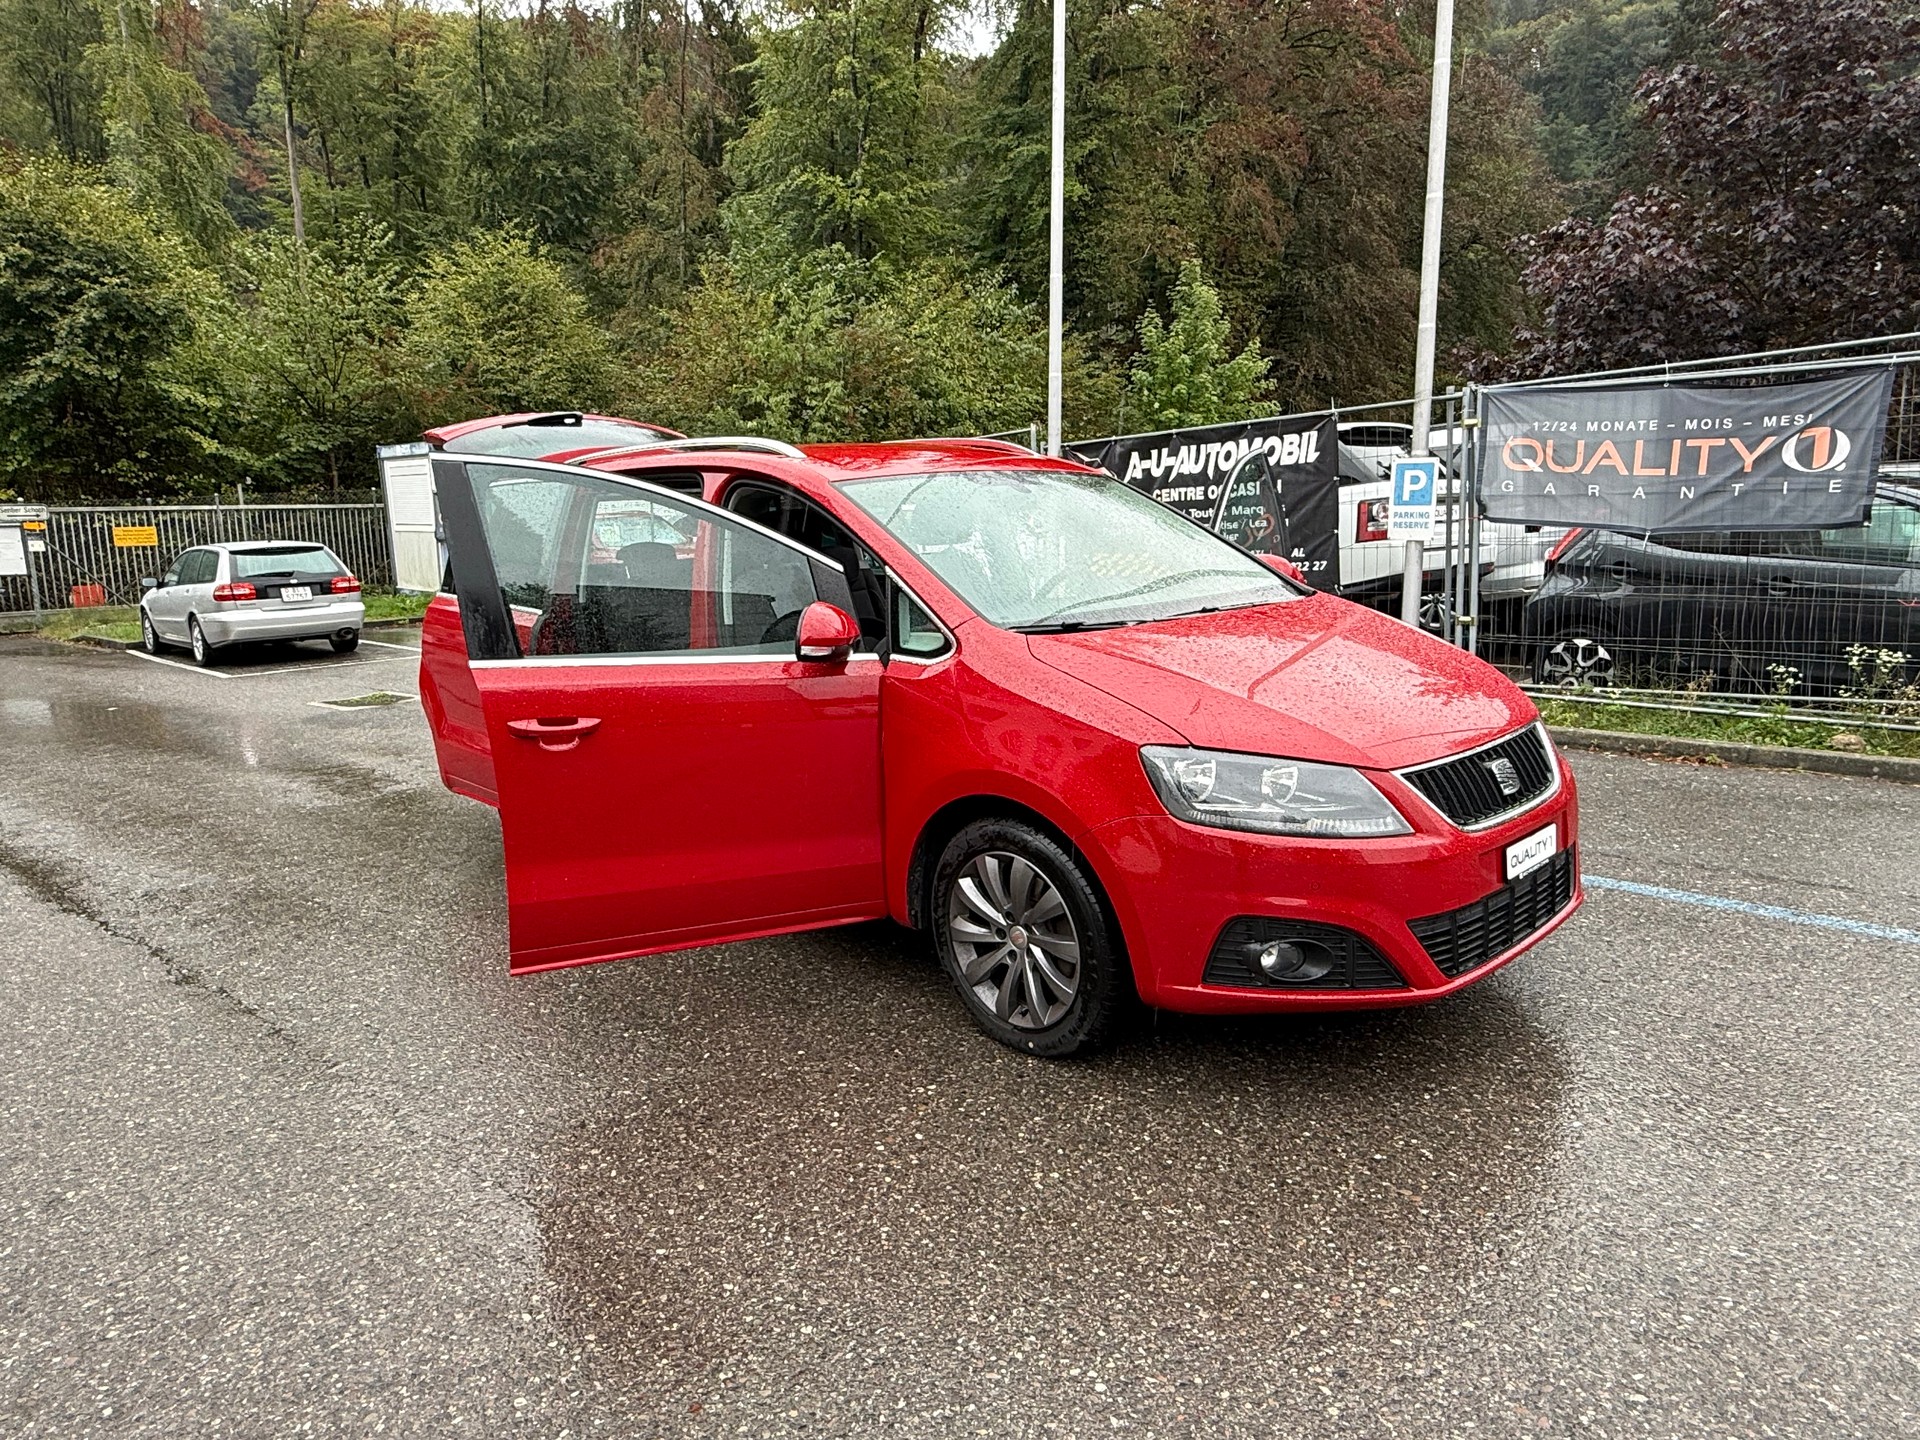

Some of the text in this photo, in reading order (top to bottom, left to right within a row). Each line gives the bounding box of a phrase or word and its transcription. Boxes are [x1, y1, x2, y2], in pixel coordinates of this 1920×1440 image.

[1532, 420, 1577, 432] 12/24
[1586, 419, 1658, 432] MONATE
[1684, 418, 1733, 430] MOIS
[1763, 413, 1814, 427] MESI
[1502, 435, 1778, 476] QUALITY
[1153, 486, 1204, 502] CENTRE
[1402, 469, 1427, 501] P
[1501, 479, 1843, 500] GARANTIE
[1393, 511, 1430, 519] PARKING
[1393, 521, 1430, 529] RESERVE
[1312, 560, 1328, 571] 27
[1511, 837, 1548, 868] QUALITY
